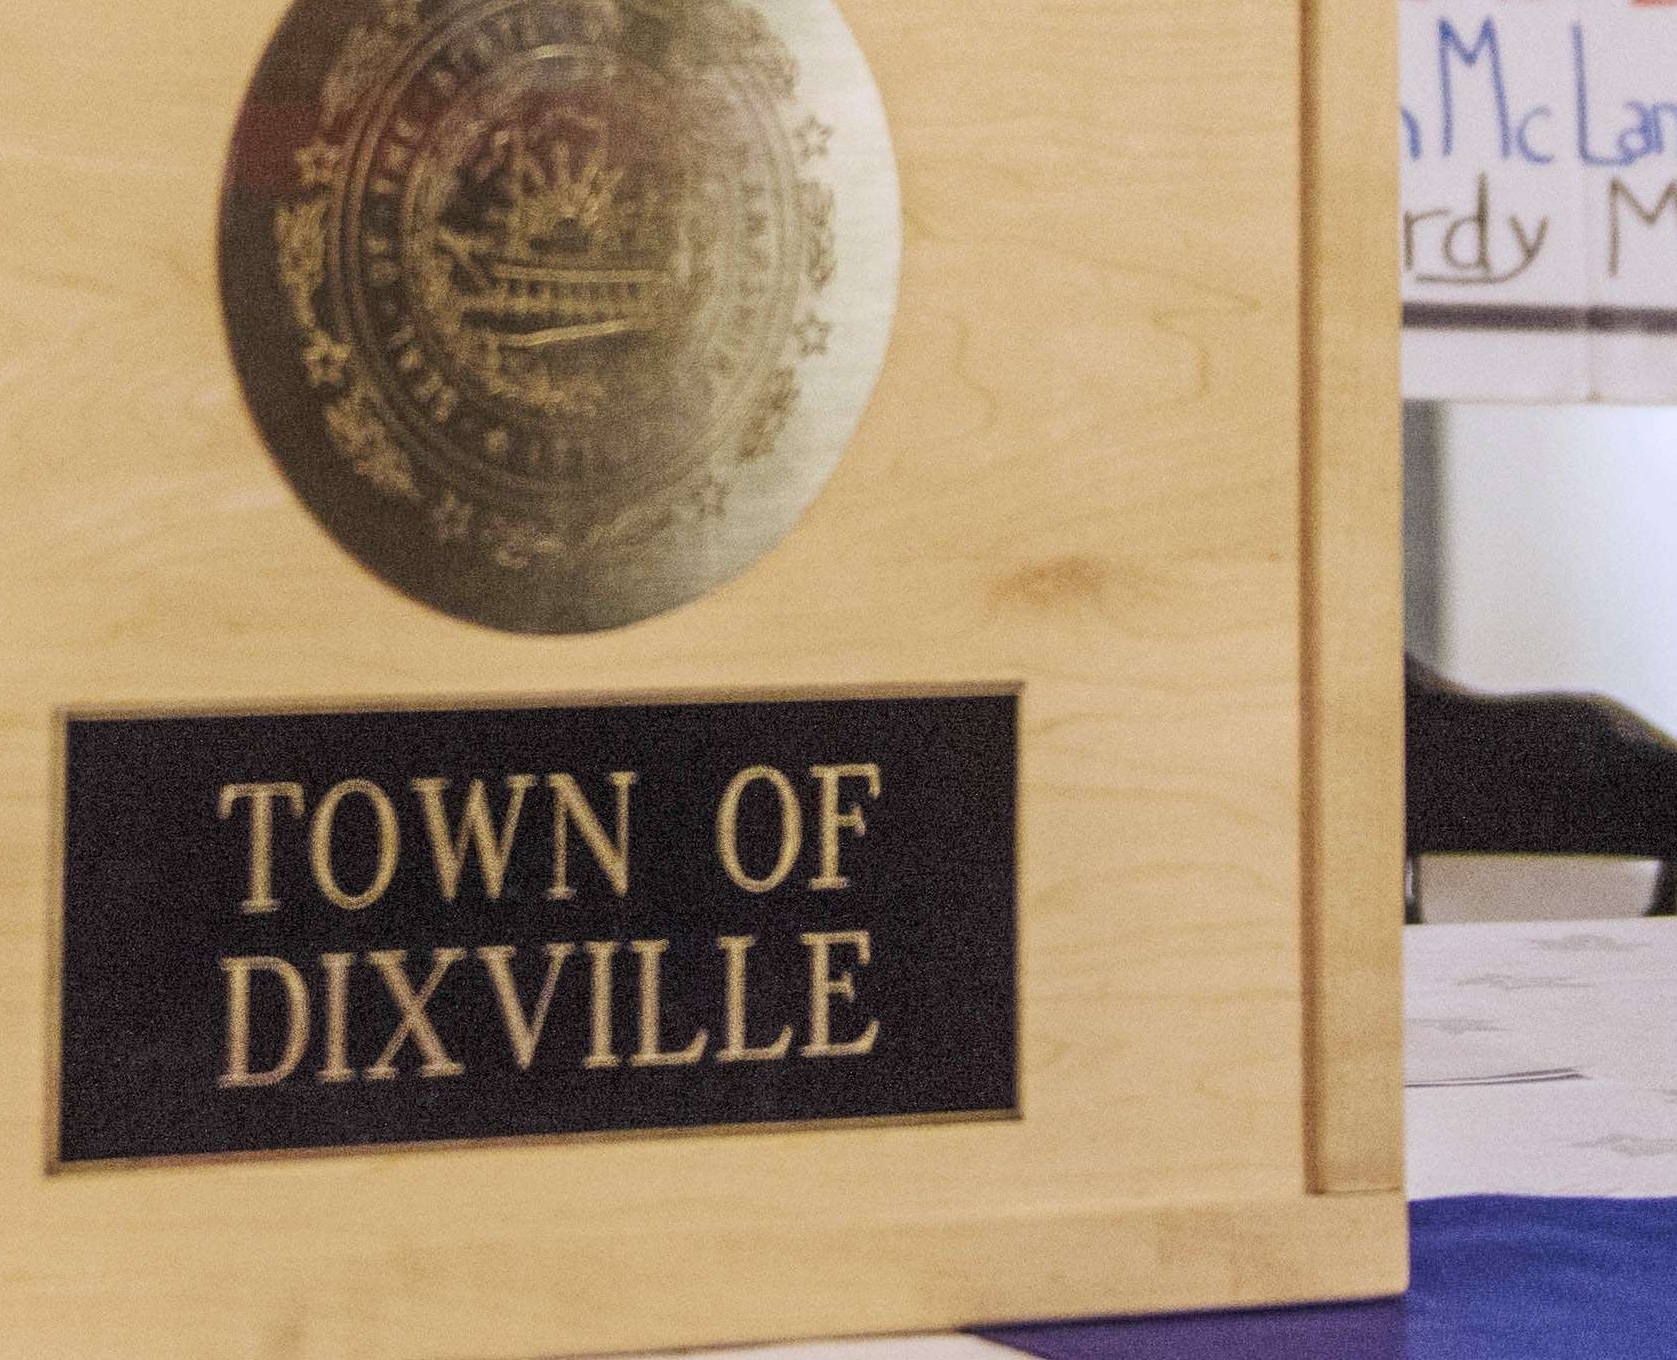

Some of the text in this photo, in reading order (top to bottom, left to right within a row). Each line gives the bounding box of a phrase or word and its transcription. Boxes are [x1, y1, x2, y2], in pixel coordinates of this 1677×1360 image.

[215, 761, 883, 917] TOWN OF
[217, 929, 881, 1089] DIXVILLE
